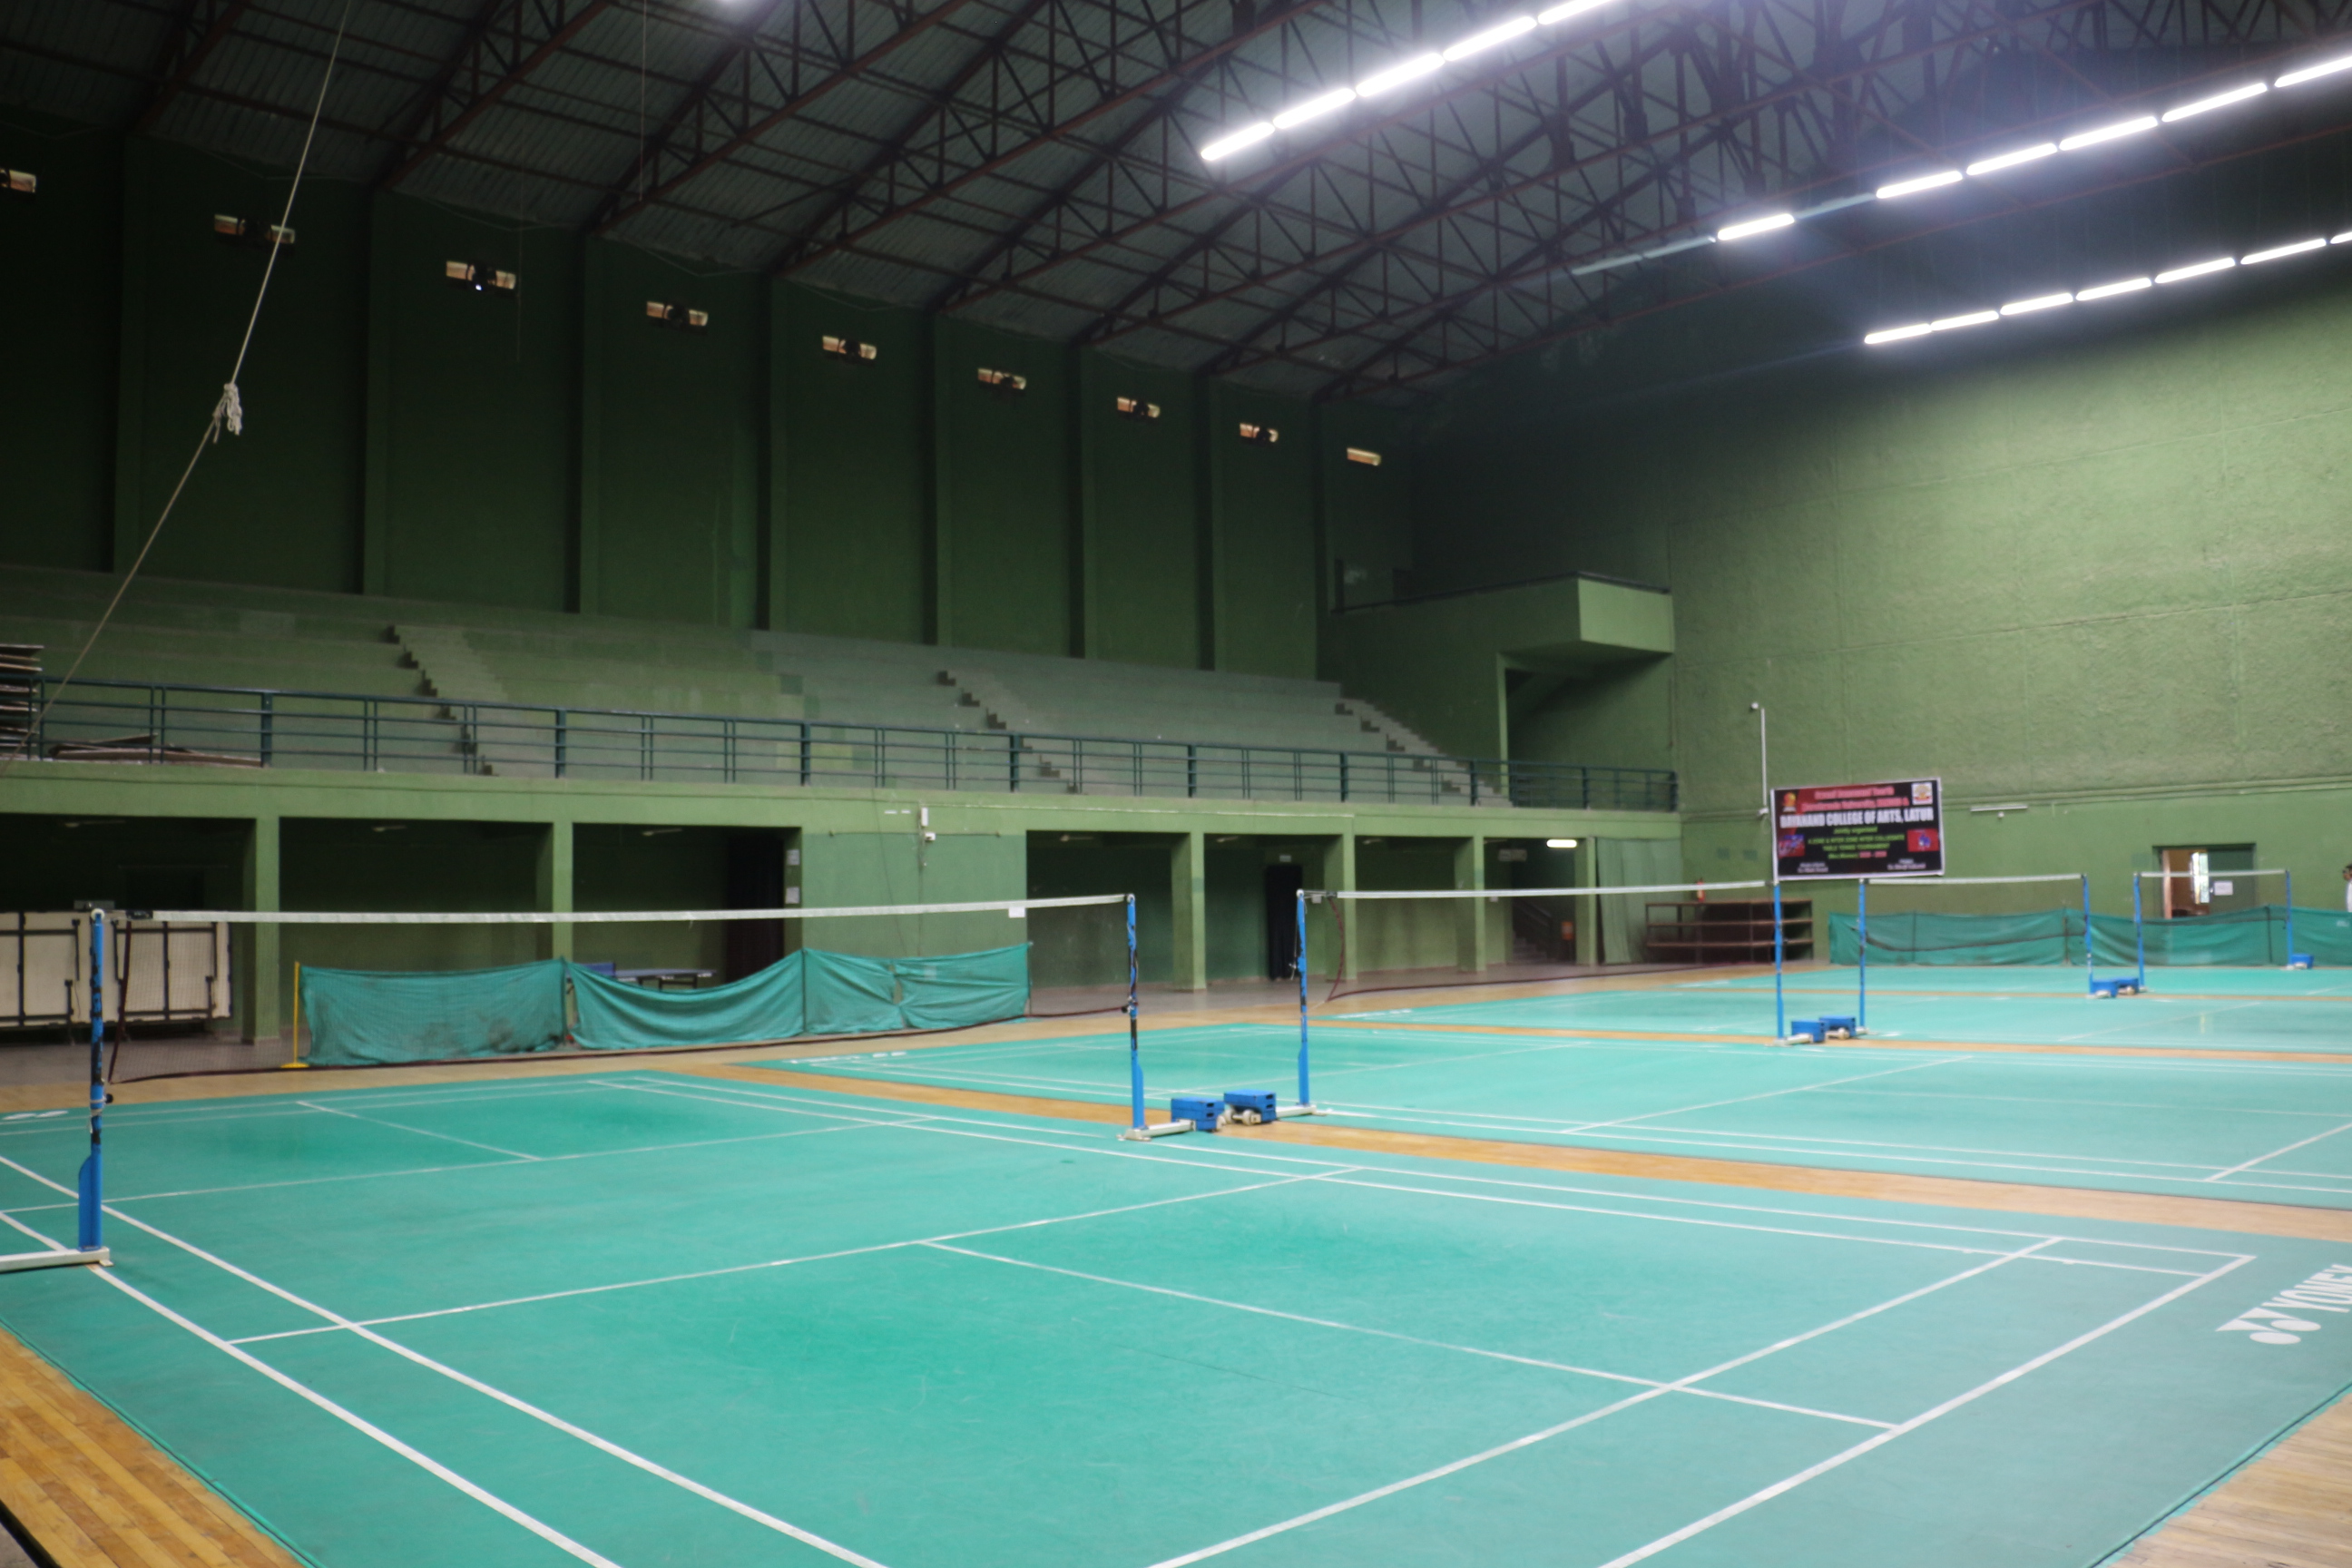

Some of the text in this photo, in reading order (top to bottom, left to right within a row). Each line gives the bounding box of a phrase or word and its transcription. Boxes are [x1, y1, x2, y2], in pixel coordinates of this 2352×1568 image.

[1826, 811, 1864, 827] COLLEGE
[1864, 810, 1877, 824] OF
[1877, 808, 1904, 824] ARTS,
[1904, 807, 1935, 822] LATUR
